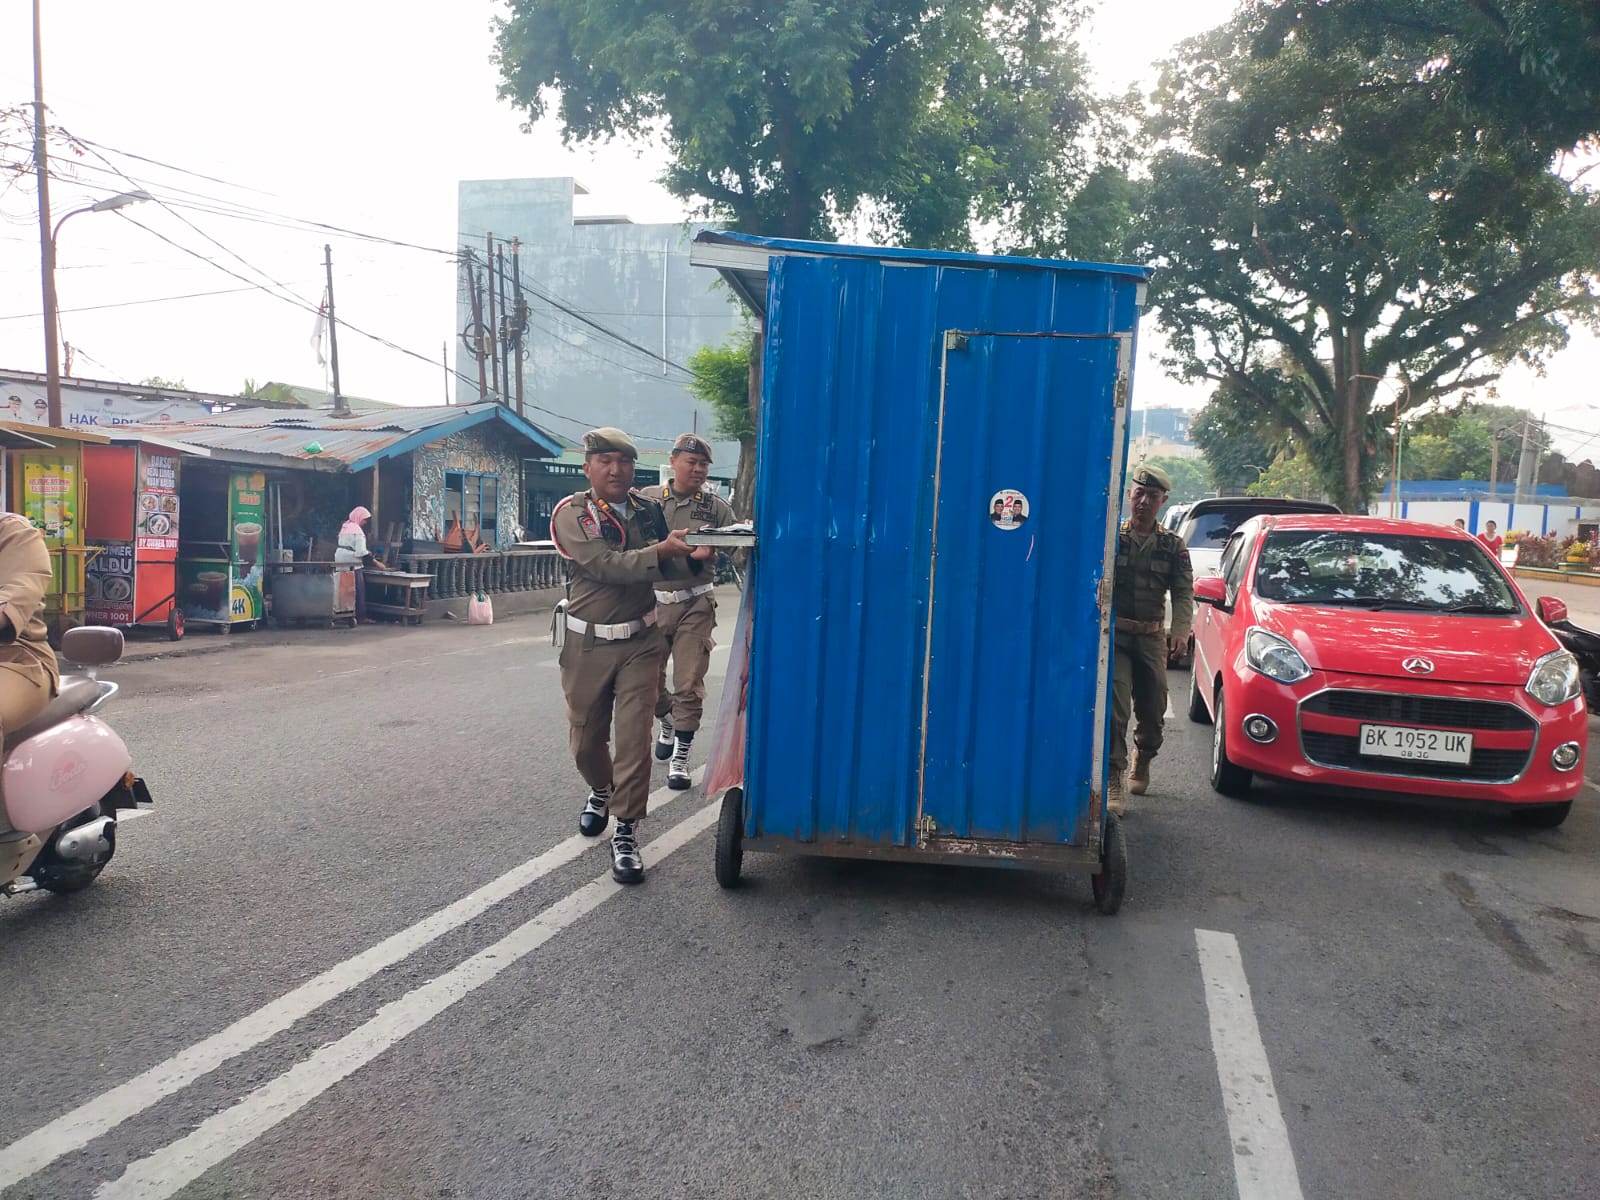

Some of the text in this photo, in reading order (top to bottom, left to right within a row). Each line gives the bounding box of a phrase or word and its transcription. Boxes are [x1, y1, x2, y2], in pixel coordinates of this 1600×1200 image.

[1005, 495, 1014, 508] 2
[86, 557, 132, 574] ALDU
[231, 598, 246, 615] 4K
[110, 612, 129, 621] 1001
[1365, 728, 1466, 753] BK 1952 UK
